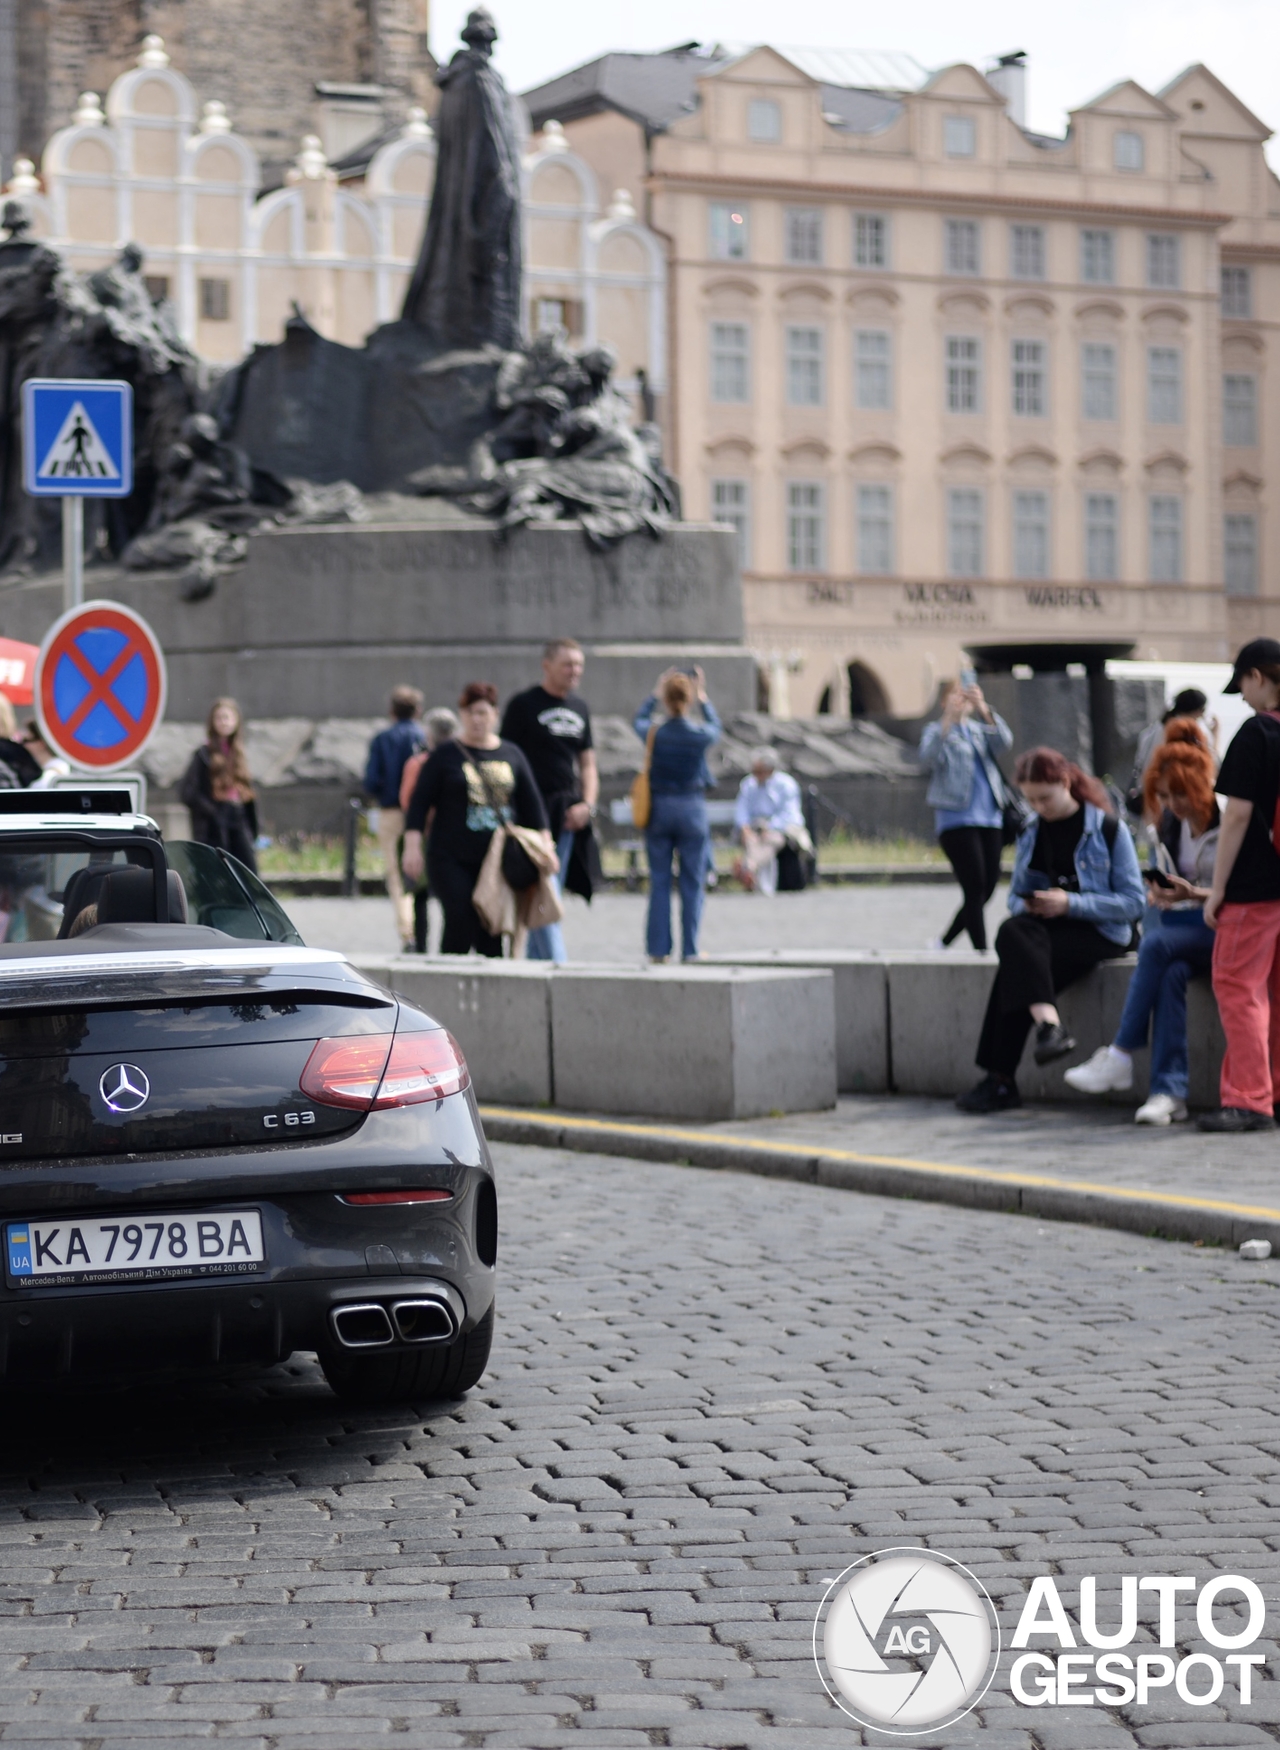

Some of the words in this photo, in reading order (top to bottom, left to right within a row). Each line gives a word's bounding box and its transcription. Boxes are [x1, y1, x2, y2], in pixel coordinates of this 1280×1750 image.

[263, 1115, 278, 1128] C
[284, 1111, 316, 1126] 63
[33, 1227, 91, 1267] KA
[100, 1222, 188, 1263] 7978
[196, 1219, 252, 1258] BA
[12, 1256, 30, 1269] UA
[20, 1274, 75, 1287] Mercedes-Benz
[82, 1269, 144, 1282] Автомобільний
[145, 1268, 161, 1278] Дім
[161, 1266, 193, 1278] Україна
[208, 1264, 222, 1273] 044
[223, 1263, 236, 1272] 201
[237, 1263, 247, 1271] 60
[248, 1262, 258, 1271] 00
